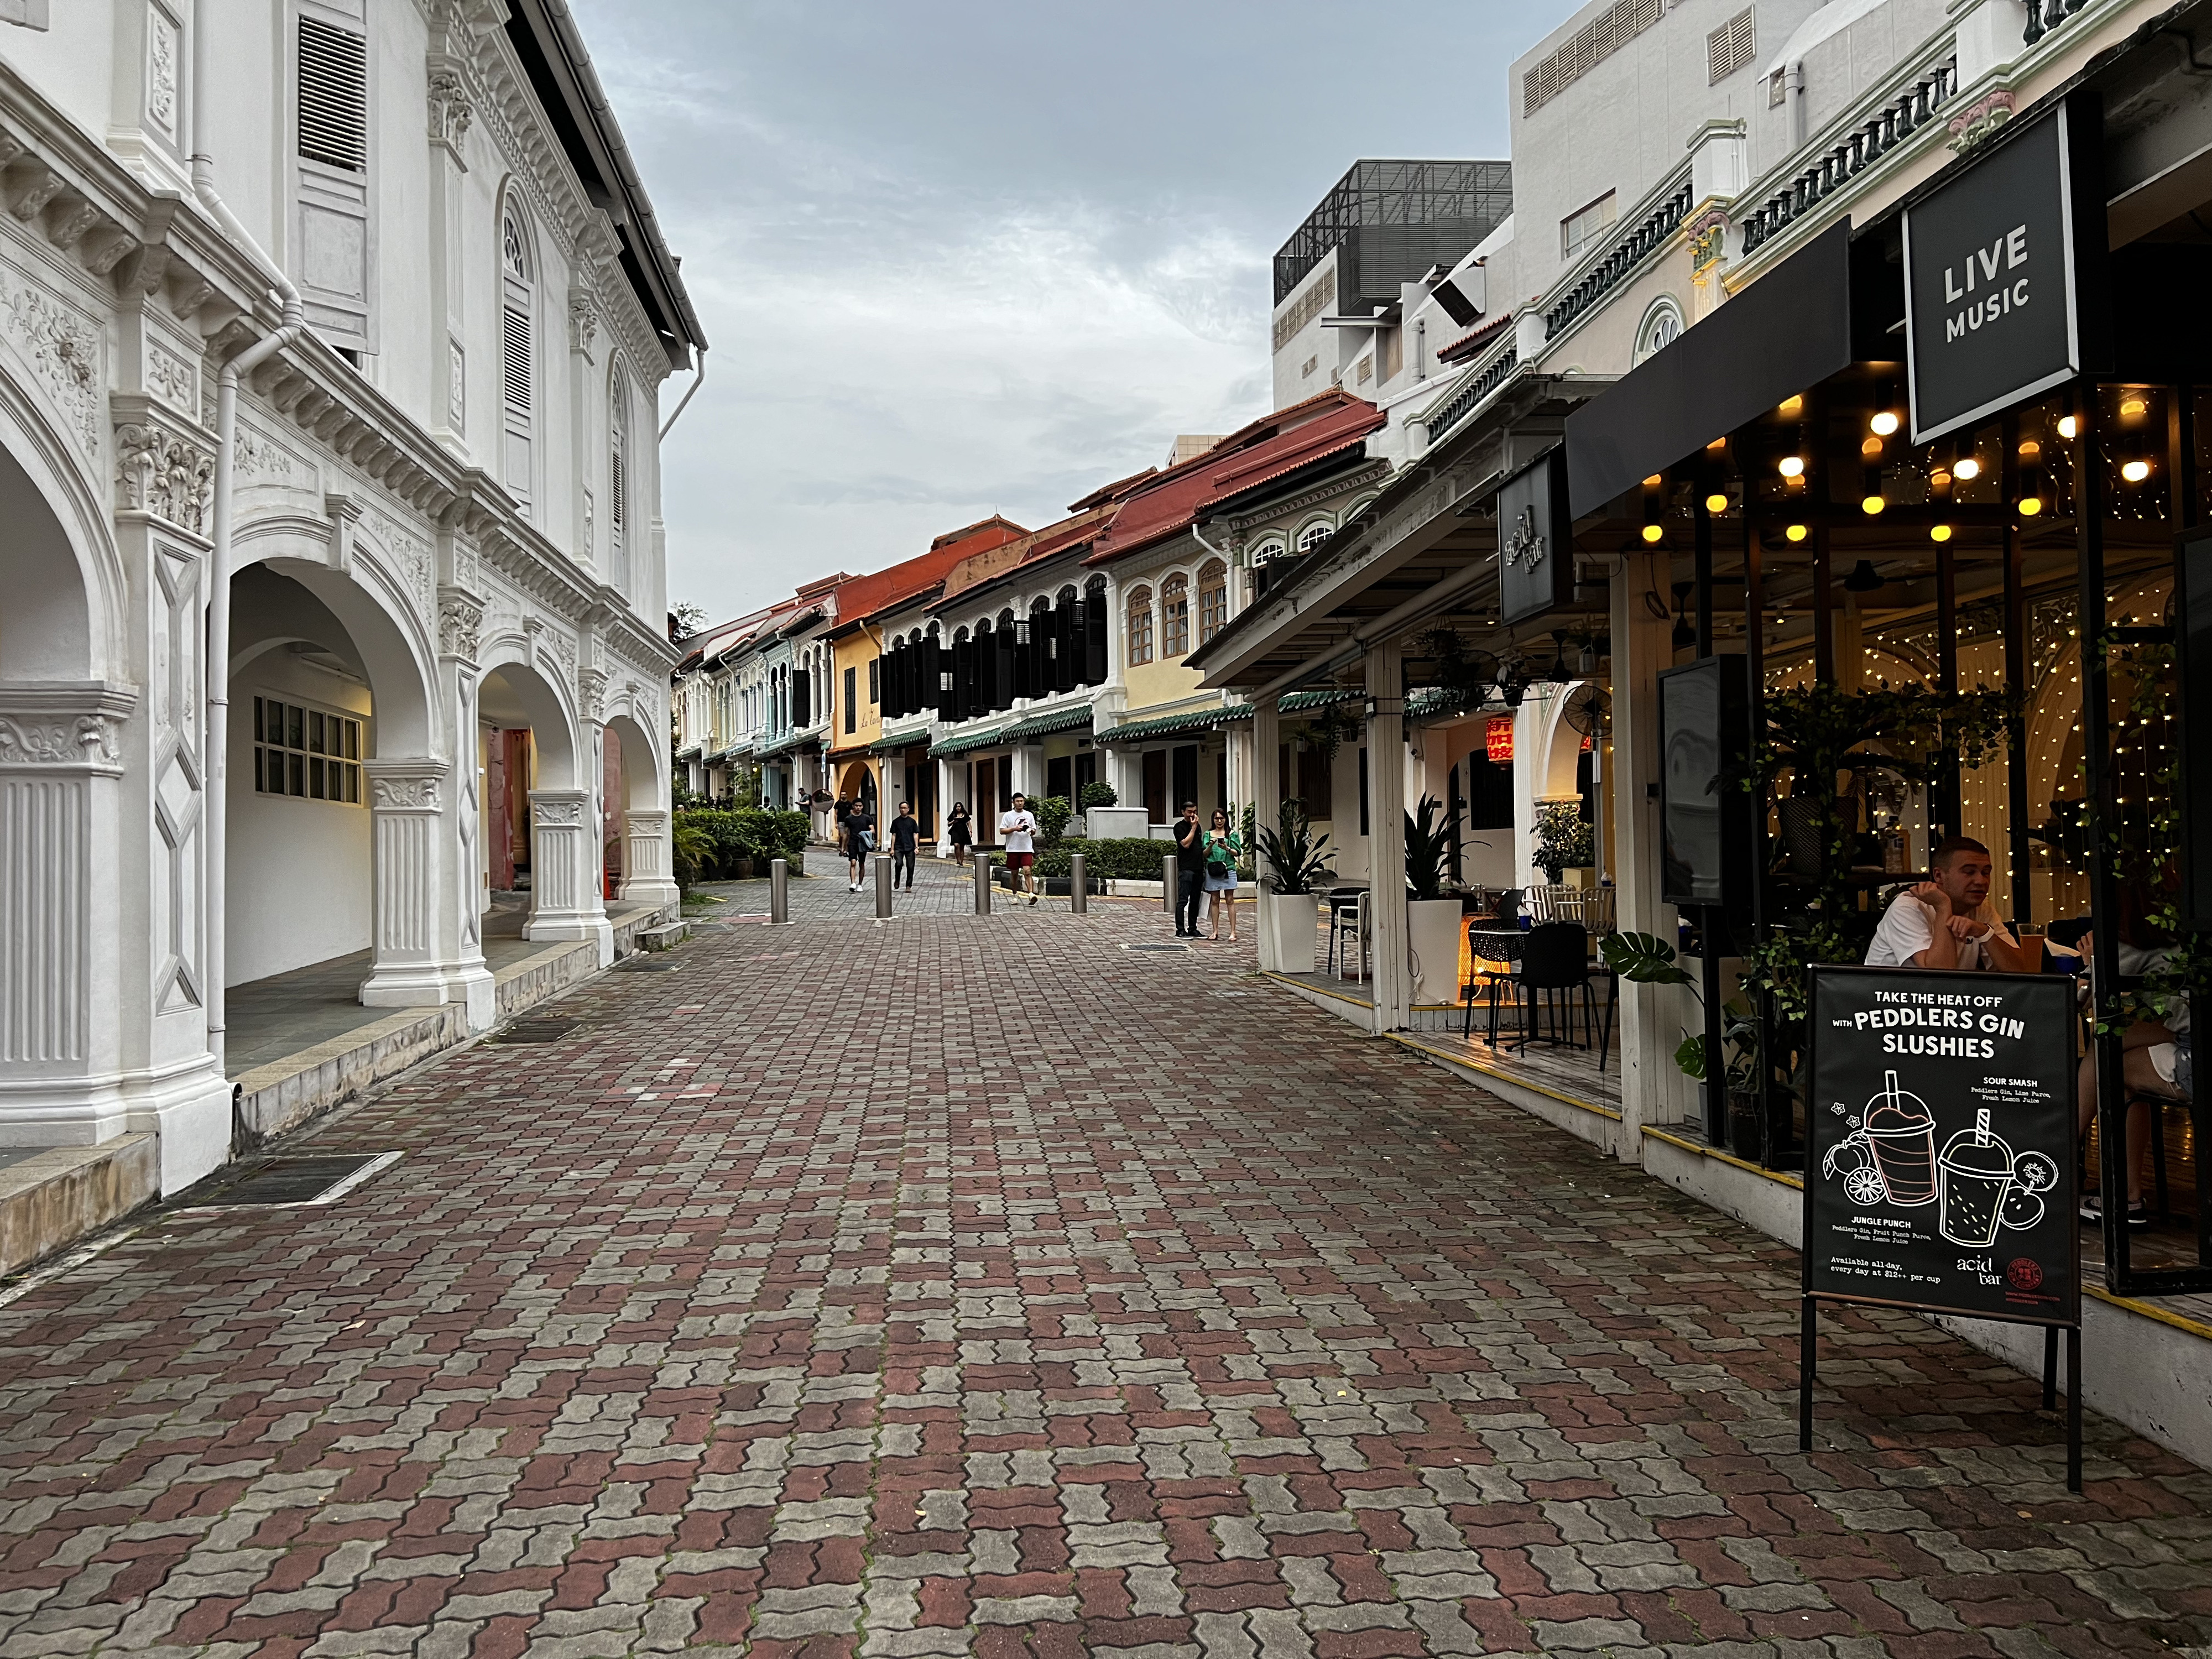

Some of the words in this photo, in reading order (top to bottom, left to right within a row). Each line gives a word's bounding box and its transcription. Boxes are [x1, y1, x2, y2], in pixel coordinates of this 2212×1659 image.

[1945, 224, 2027, 304] LIVE
[1947, 278, 2029, 343] MUSIC
[1486, 719, 1512, 759] 新加坡
[1875, 991, 1908, 1003] TAKE
[1910, 993, 1934, 1004] THE
[1938, 994, 1971, 1006] HEAT
[1973, 995, 2002, 1008] OFF
[1833, 1019, 1852, 1027] WITH
[1854, 1008, 1973, 1030] PEDDLERS
[1979, 1013, 2025, 1040] GIN
[1882, 1033, 1994, 1058] SLUSHIES
[1983, 1077, 2006, 1085] SOUR
[2008, 1079, 2037, 1087] SMASH
[1851, 1216, 1882, 1225] JUNGLE
[1883, 1219, 1911, 1229] PUNCH
[1831, 1256, 1869, 1266] Available
[1872, 1261, 1902, 1271] all-day,
[1957, 1255, 1992, 1272] acid
[1830, 1266, 1852, 1274] every
[1855, 1267, 1869, 1276] day
[1885, 1270, 1907, 1279] $12++
[1927, 1275, 1940, 1284] cup
[1979, 1272, 2002, 1285] bar
